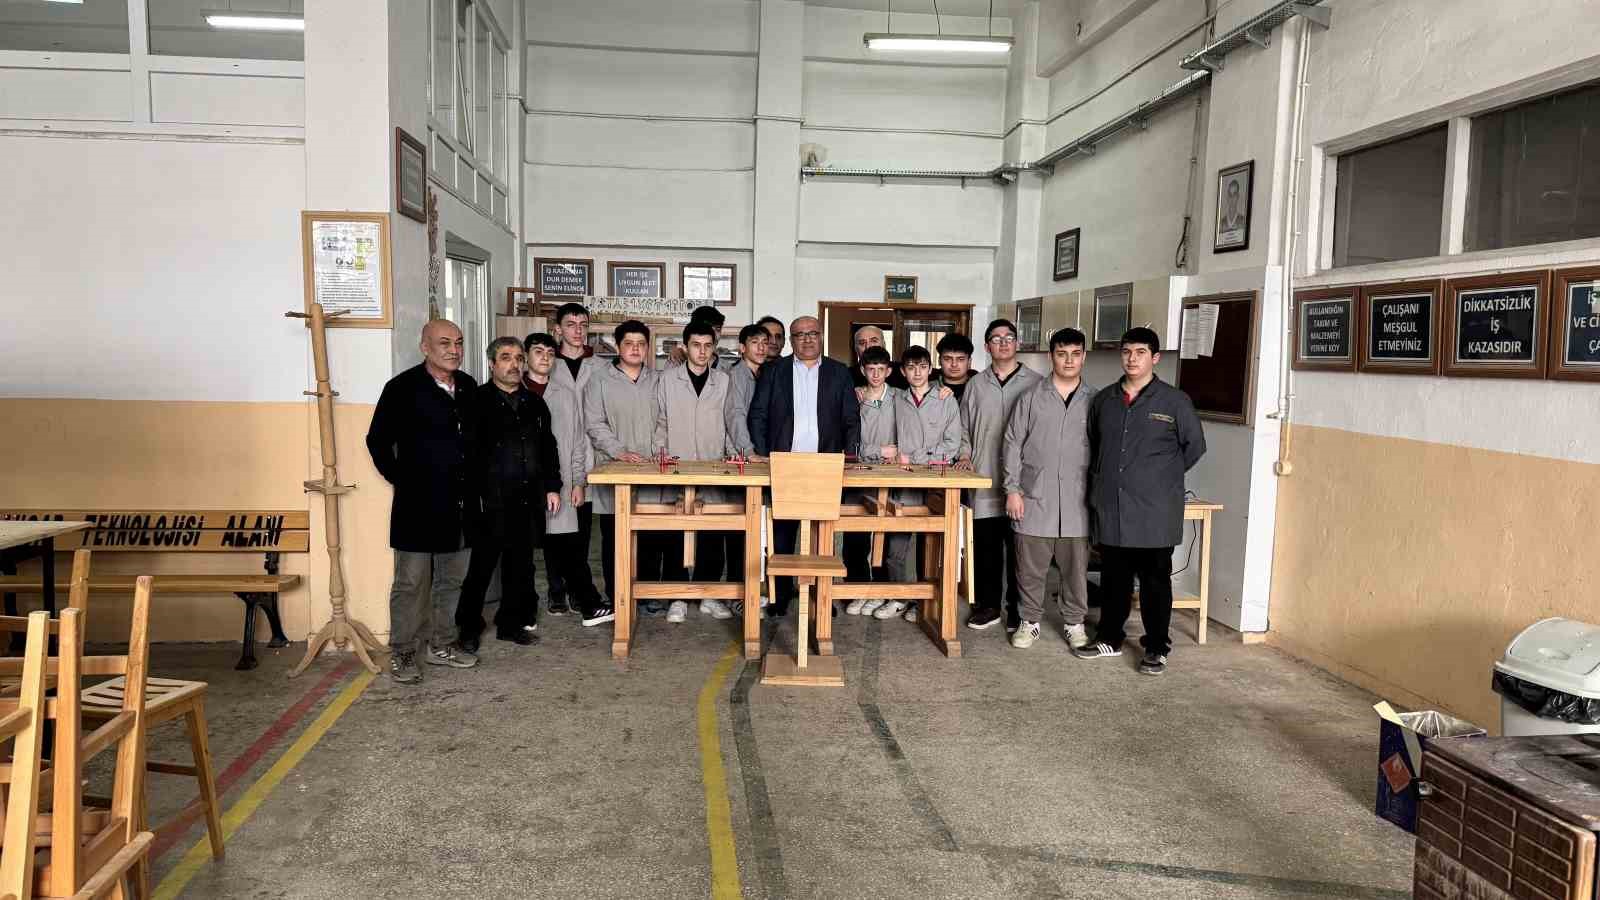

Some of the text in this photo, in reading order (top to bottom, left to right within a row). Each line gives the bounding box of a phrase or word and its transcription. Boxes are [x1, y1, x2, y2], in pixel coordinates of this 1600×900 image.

[1463, 294, 1532, 312] DİKKATSİZLİK
[1382, 303, 1419, 318] ÇALIŞANI
[1331, 318, 1341, 327] VE
[1383, 321, 1417, 335] MEŞGUL
[1490, 316, 1500, 334] İŞ
[1573, 316, 1587, 328] VE
[1328, 343, 1341, 352] KOY
[1378, 337, 1422, 351] ETMEYİNİZ
[1468, 340, 1522, 353] KAZASIDIR
[220, 515, 284, 546] ALANI
